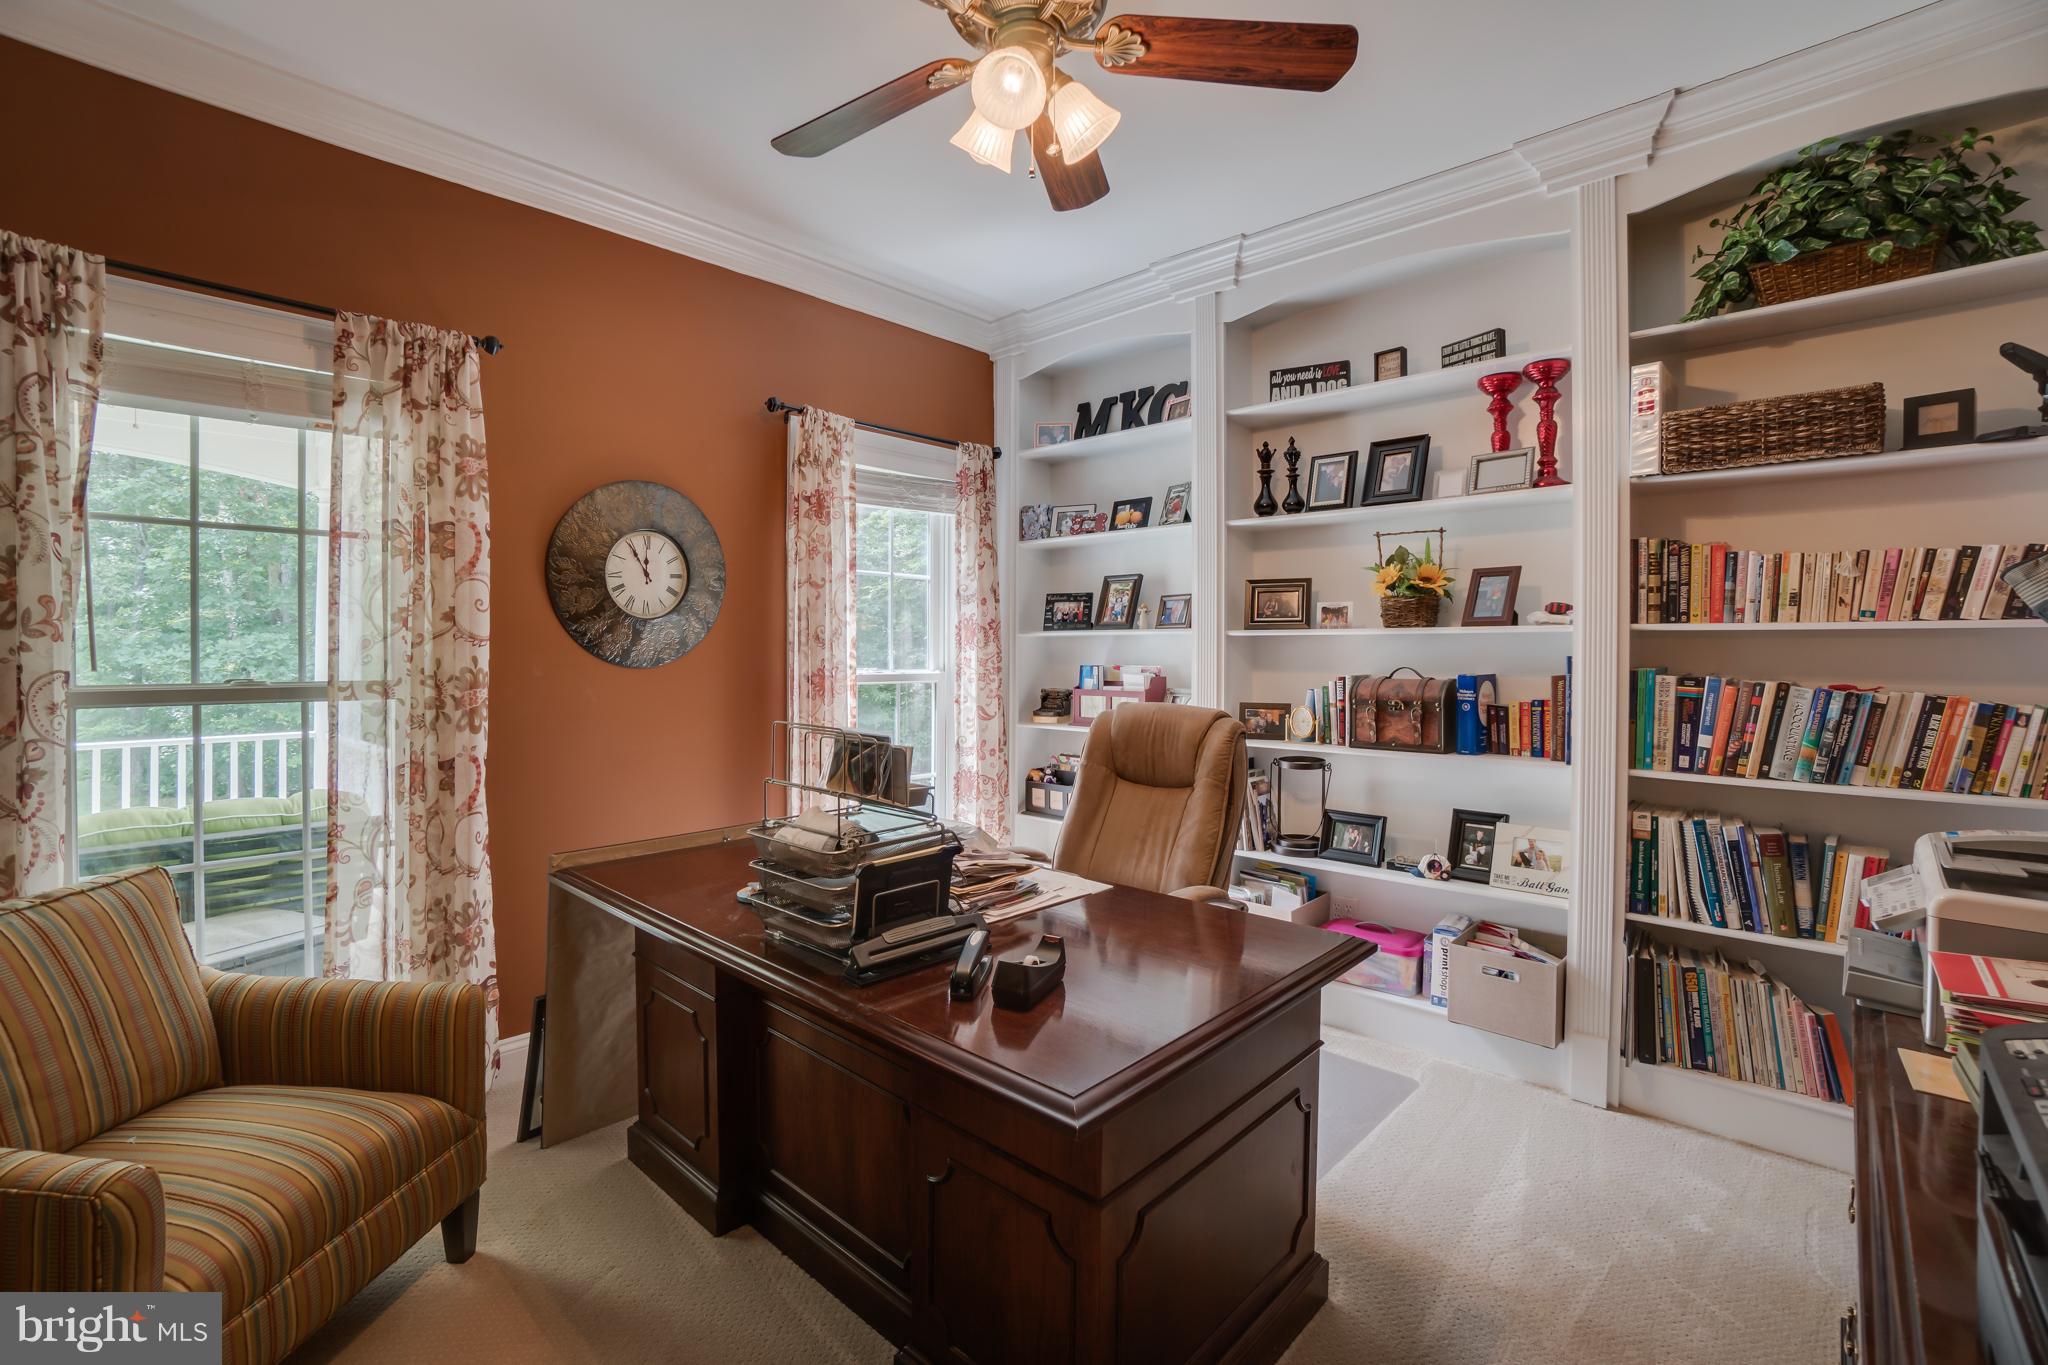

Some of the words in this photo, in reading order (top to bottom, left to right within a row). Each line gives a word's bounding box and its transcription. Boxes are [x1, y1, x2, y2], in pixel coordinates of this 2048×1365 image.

[1272, 372, 1282, 384] all
[1282, 374, 1296, 386] you
[1297, 367, 1315, 380] need
[1316, 368, 1322, 379] is
[1272, 384, 1300, 402] AND
[1304, 382, 1313, 396] A
[1703, 692, 1715, 725] management
[1815, 691, 1827, 714] GENERAL
[1808, 713, 1821, 740] STATISTICS
[1843, 722, 1851, 736] United
[1928, 712, 1942, 730] BLACK
[1781, 702, 1806, 762] ACCOUNTING
[1922, 728, 1938, 749] SEXUAL
[1982, 710, 2004, 754] PRINCESS
[1861, 746, 1871, 764] POWER
[1916, 746, 1932, 770] POLITICS
[1700, 834, 1712, 871] ORGANIZATIONAL
[1708, 871, 1716, 893] BEHAVIOR
[1824, 851, 1833, 878] Environment
[1517, 878, 1544, 890] Ball
[1772, 862, 1784, 889] Business
[1777, 889, 1787, 904] Law
[1821, 886, 1829, 902] Society
[1684, 971, 1698, 992] 650
[1691, 991, 1699, 1008] HOME
[1693, 1008, 1701, 1028] PLANS
